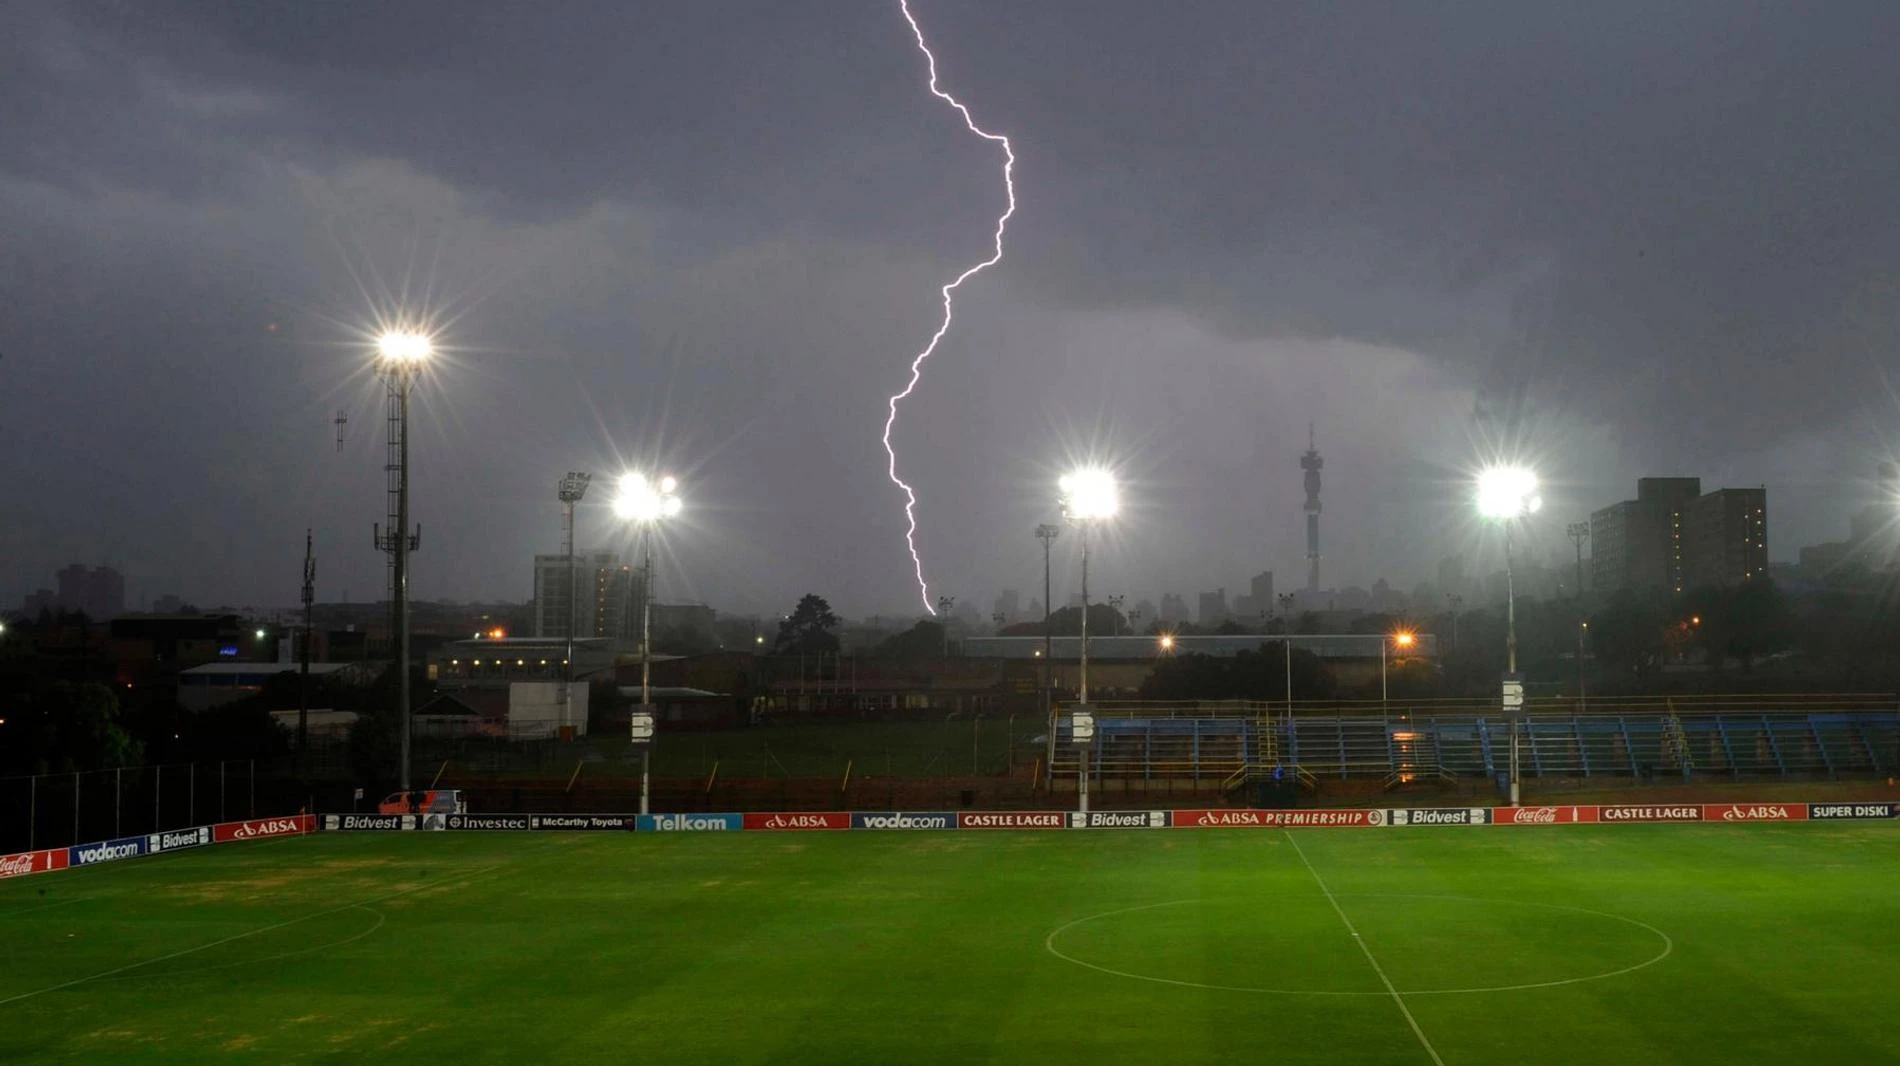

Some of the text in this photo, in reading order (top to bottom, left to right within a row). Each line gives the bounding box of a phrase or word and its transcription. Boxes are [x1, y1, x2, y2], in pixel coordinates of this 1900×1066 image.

[1220, 812, 1362, 824] ABSA PREMIERSHIP
[1413, 810, 1467, 823] Bidvest
[1605, 807, 1698, 820] CASTLE LAGER
[1747, 807, 1788, 819] ABSA
[1813, 806, 1889, 817] SUPER DISKI
[344, 816, 398, 829] Bidvest
[463, 817, 526, 829] Investec
[543, 817, 623, 828] McCarthy Toyota
[652, 814, 727, 831] Telkom
[788, 815, 828, 827] ABSA
[864, 812, 945, 829] vodacom
[964, 815, 1059, 826] CASTLE LAGER
[1091, 813, 1146, 827] Bidvest
[258, 819, 297, 835] ABSA
[163, 831, 198, 849] Bidvest
[78, 842, 138, 863] vodacom
